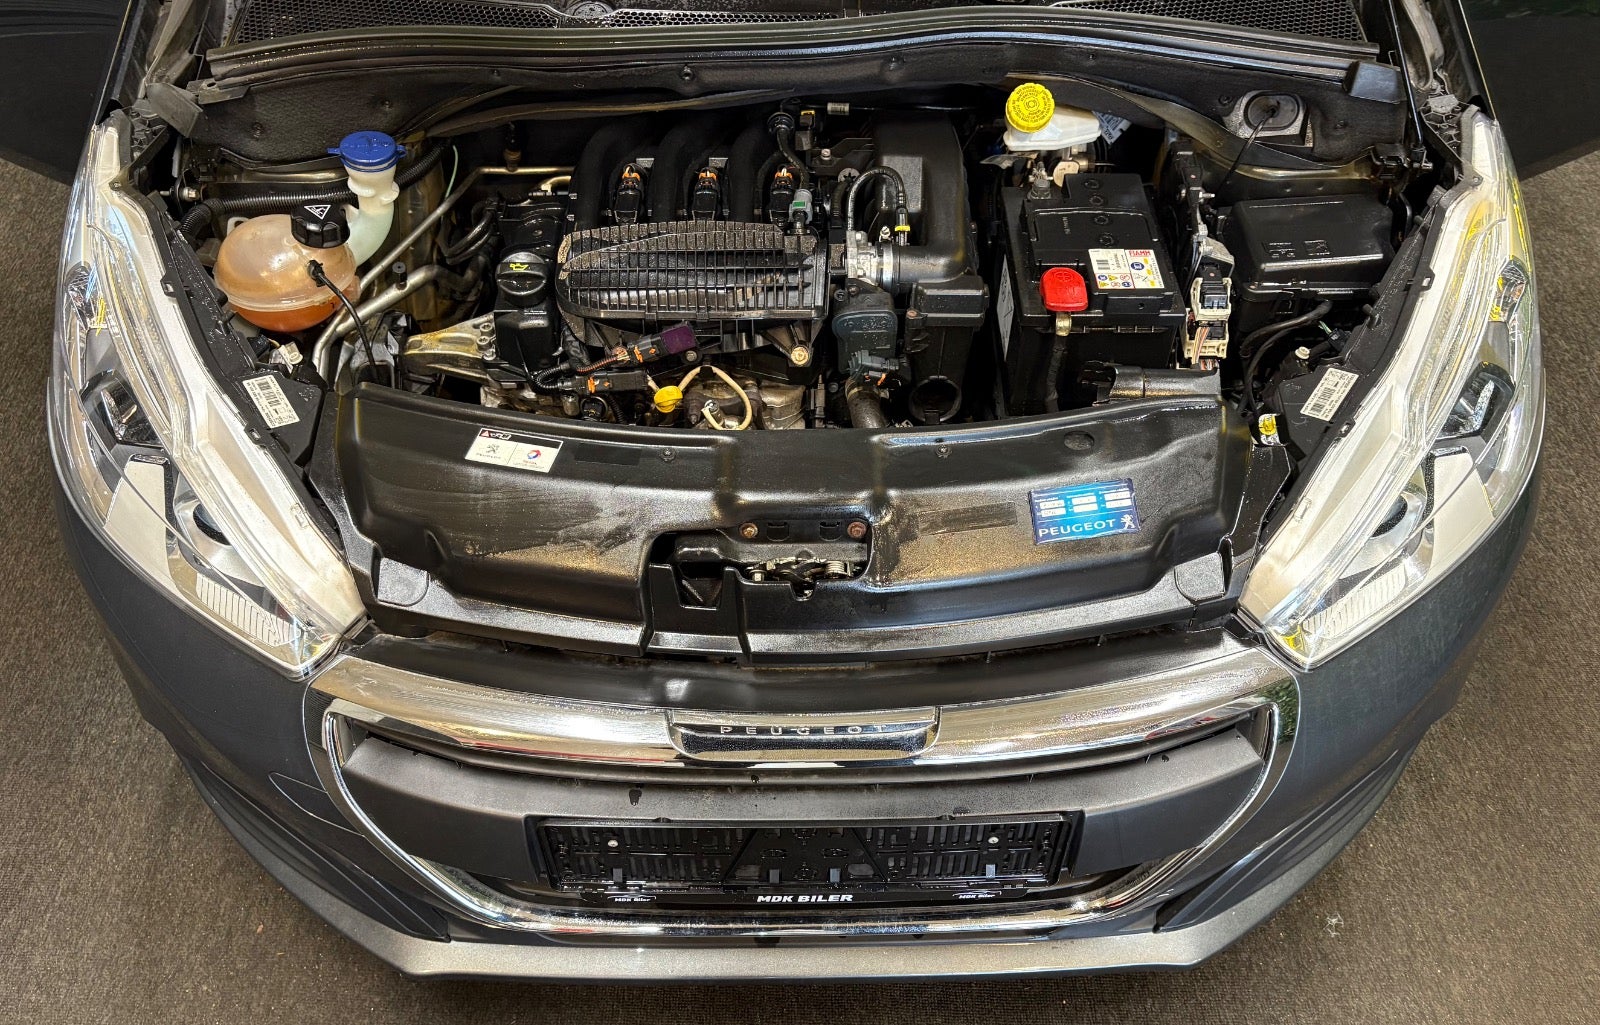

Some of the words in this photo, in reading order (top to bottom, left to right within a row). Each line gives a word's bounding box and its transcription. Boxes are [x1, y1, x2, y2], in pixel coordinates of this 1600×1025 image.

[1038, 518, 1116, 537] PEUGEOT
[720, 724, 887, 736] PEUGEOT
[756, 895, 794, 903] MDK
[797, 894, 854, 902] BILER
